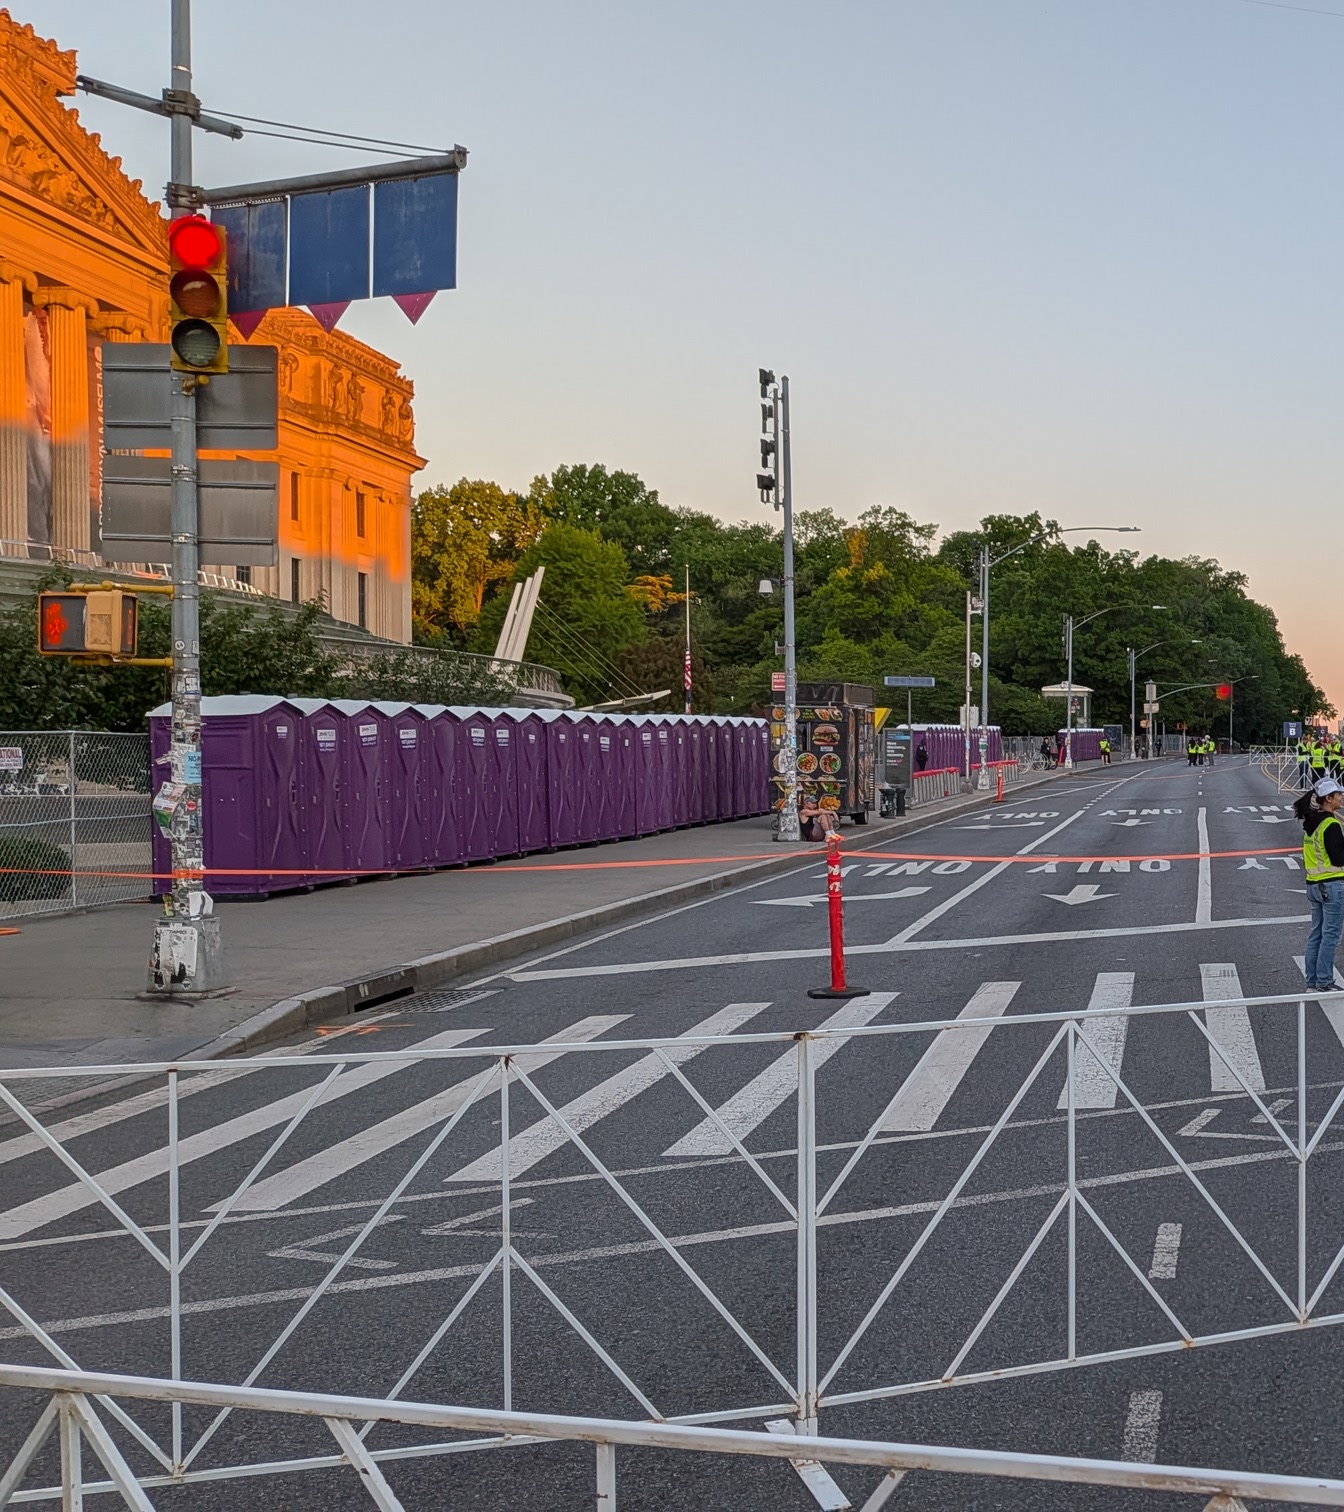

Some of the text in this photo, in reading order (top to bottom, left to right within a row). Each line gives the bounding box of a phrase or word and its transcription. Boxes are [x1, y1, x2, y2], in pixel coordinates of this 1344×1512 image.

[1289, 727, 1296, 736] B
[972, 811, 1060, 820] ONLY
[1098, 808, 1182, 816] ONLY
